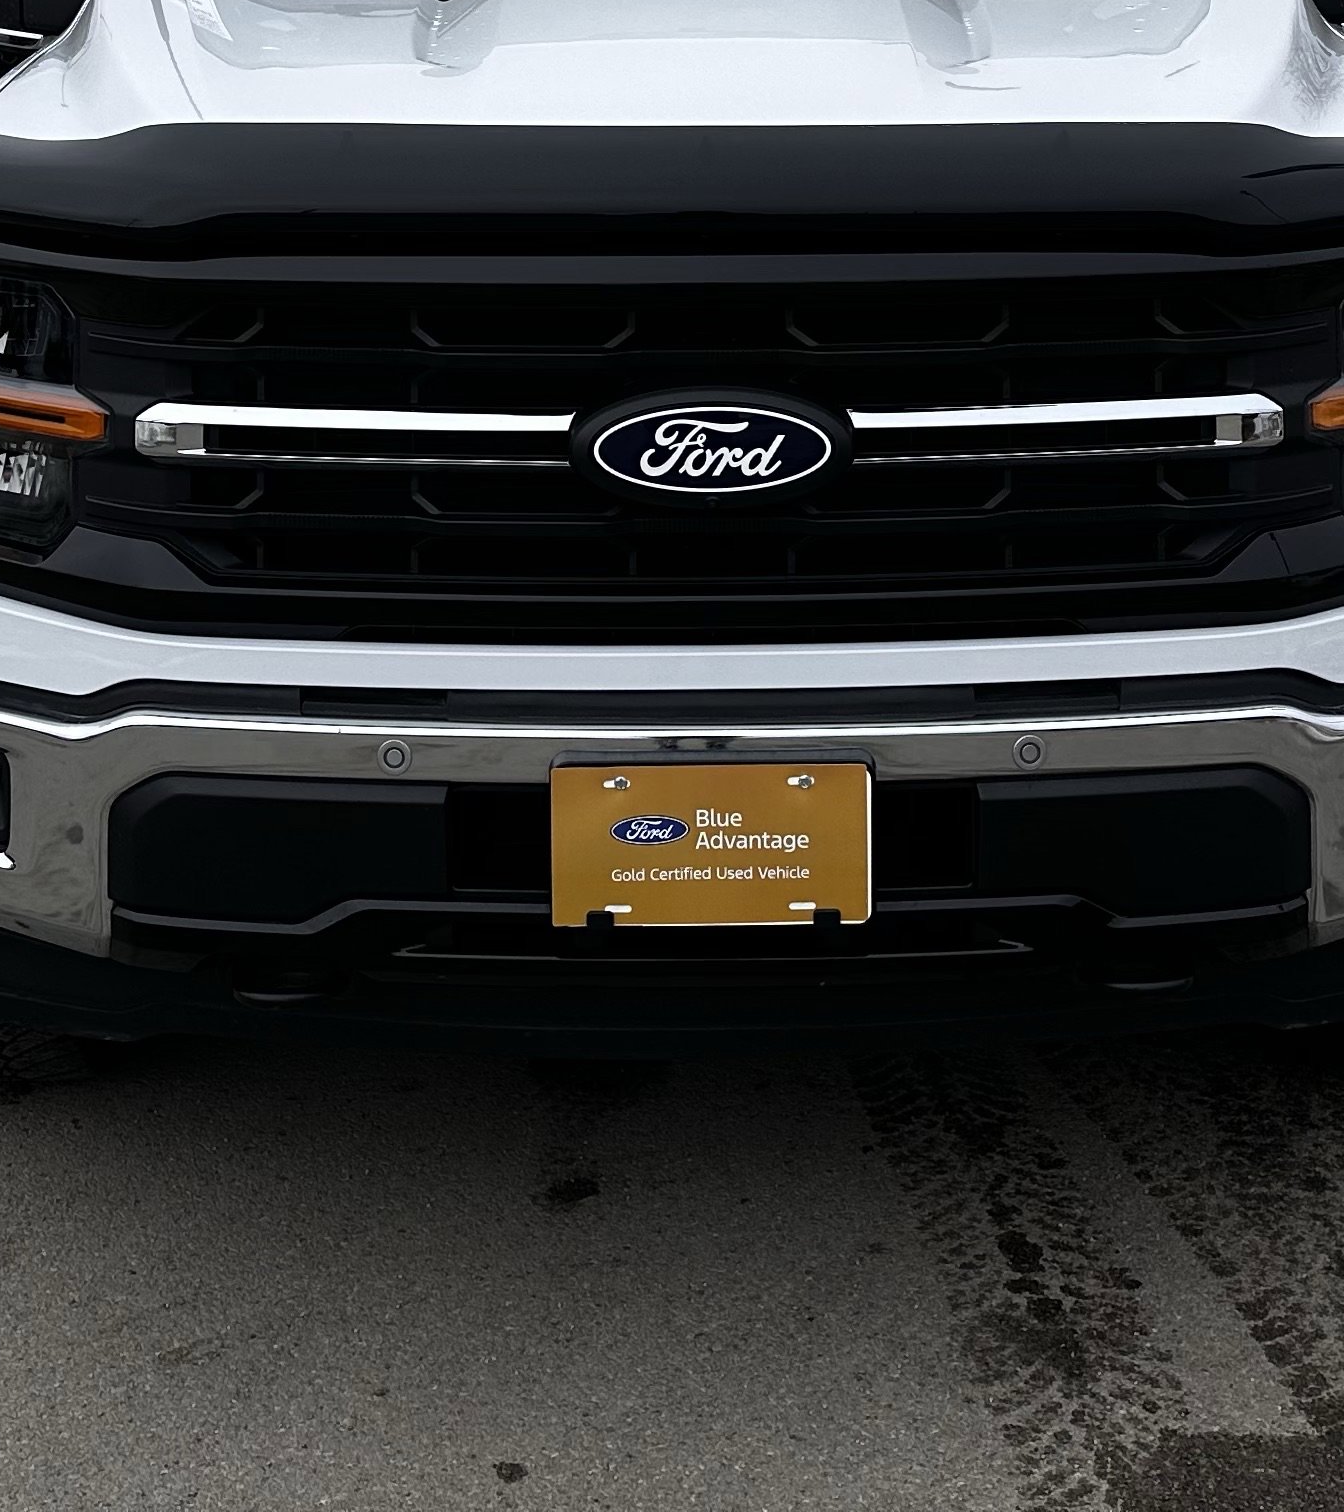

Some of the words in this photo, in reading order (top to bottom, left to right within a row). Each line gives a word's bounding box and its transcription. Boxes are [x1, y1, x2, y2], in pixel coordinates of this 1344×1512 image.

[639, 418, 786, 477] Ford
[695, 808, 743, 828] Blue
[626, 820, 673, 842] Ford
[695, 831, 810, 853] Advantage
[611, 867, 645, 883] Gold
[650, 866, 712, 882] Certified
[716, 866, 754, 881] Used
[758, 865, 810, 880] Vehicle
